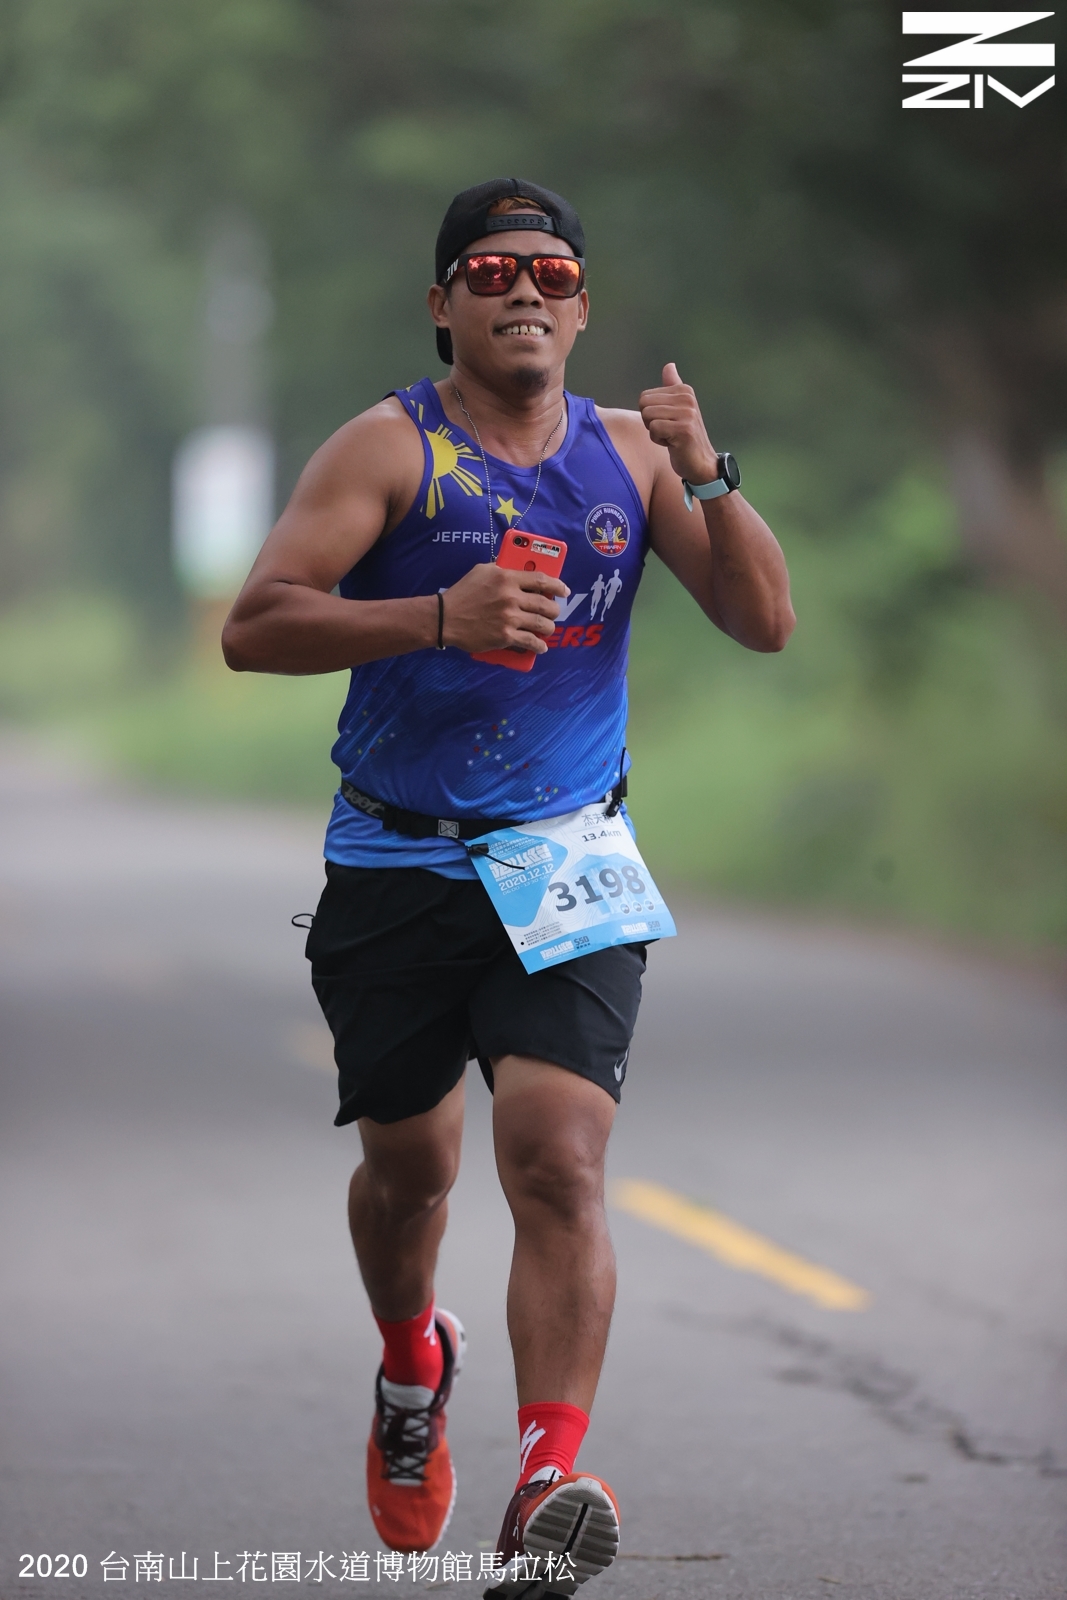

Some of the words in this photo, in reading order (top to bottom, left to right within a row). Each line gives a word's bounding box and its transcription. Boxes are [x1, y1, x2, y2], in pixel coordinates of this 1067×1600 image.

[432, 531, 499, 544] JEFFREY
[582, 829, 622, 842] 13.4km
[499, 863, 556, 891] 2020.12.12
[548, 865, 646, 912] 3198
